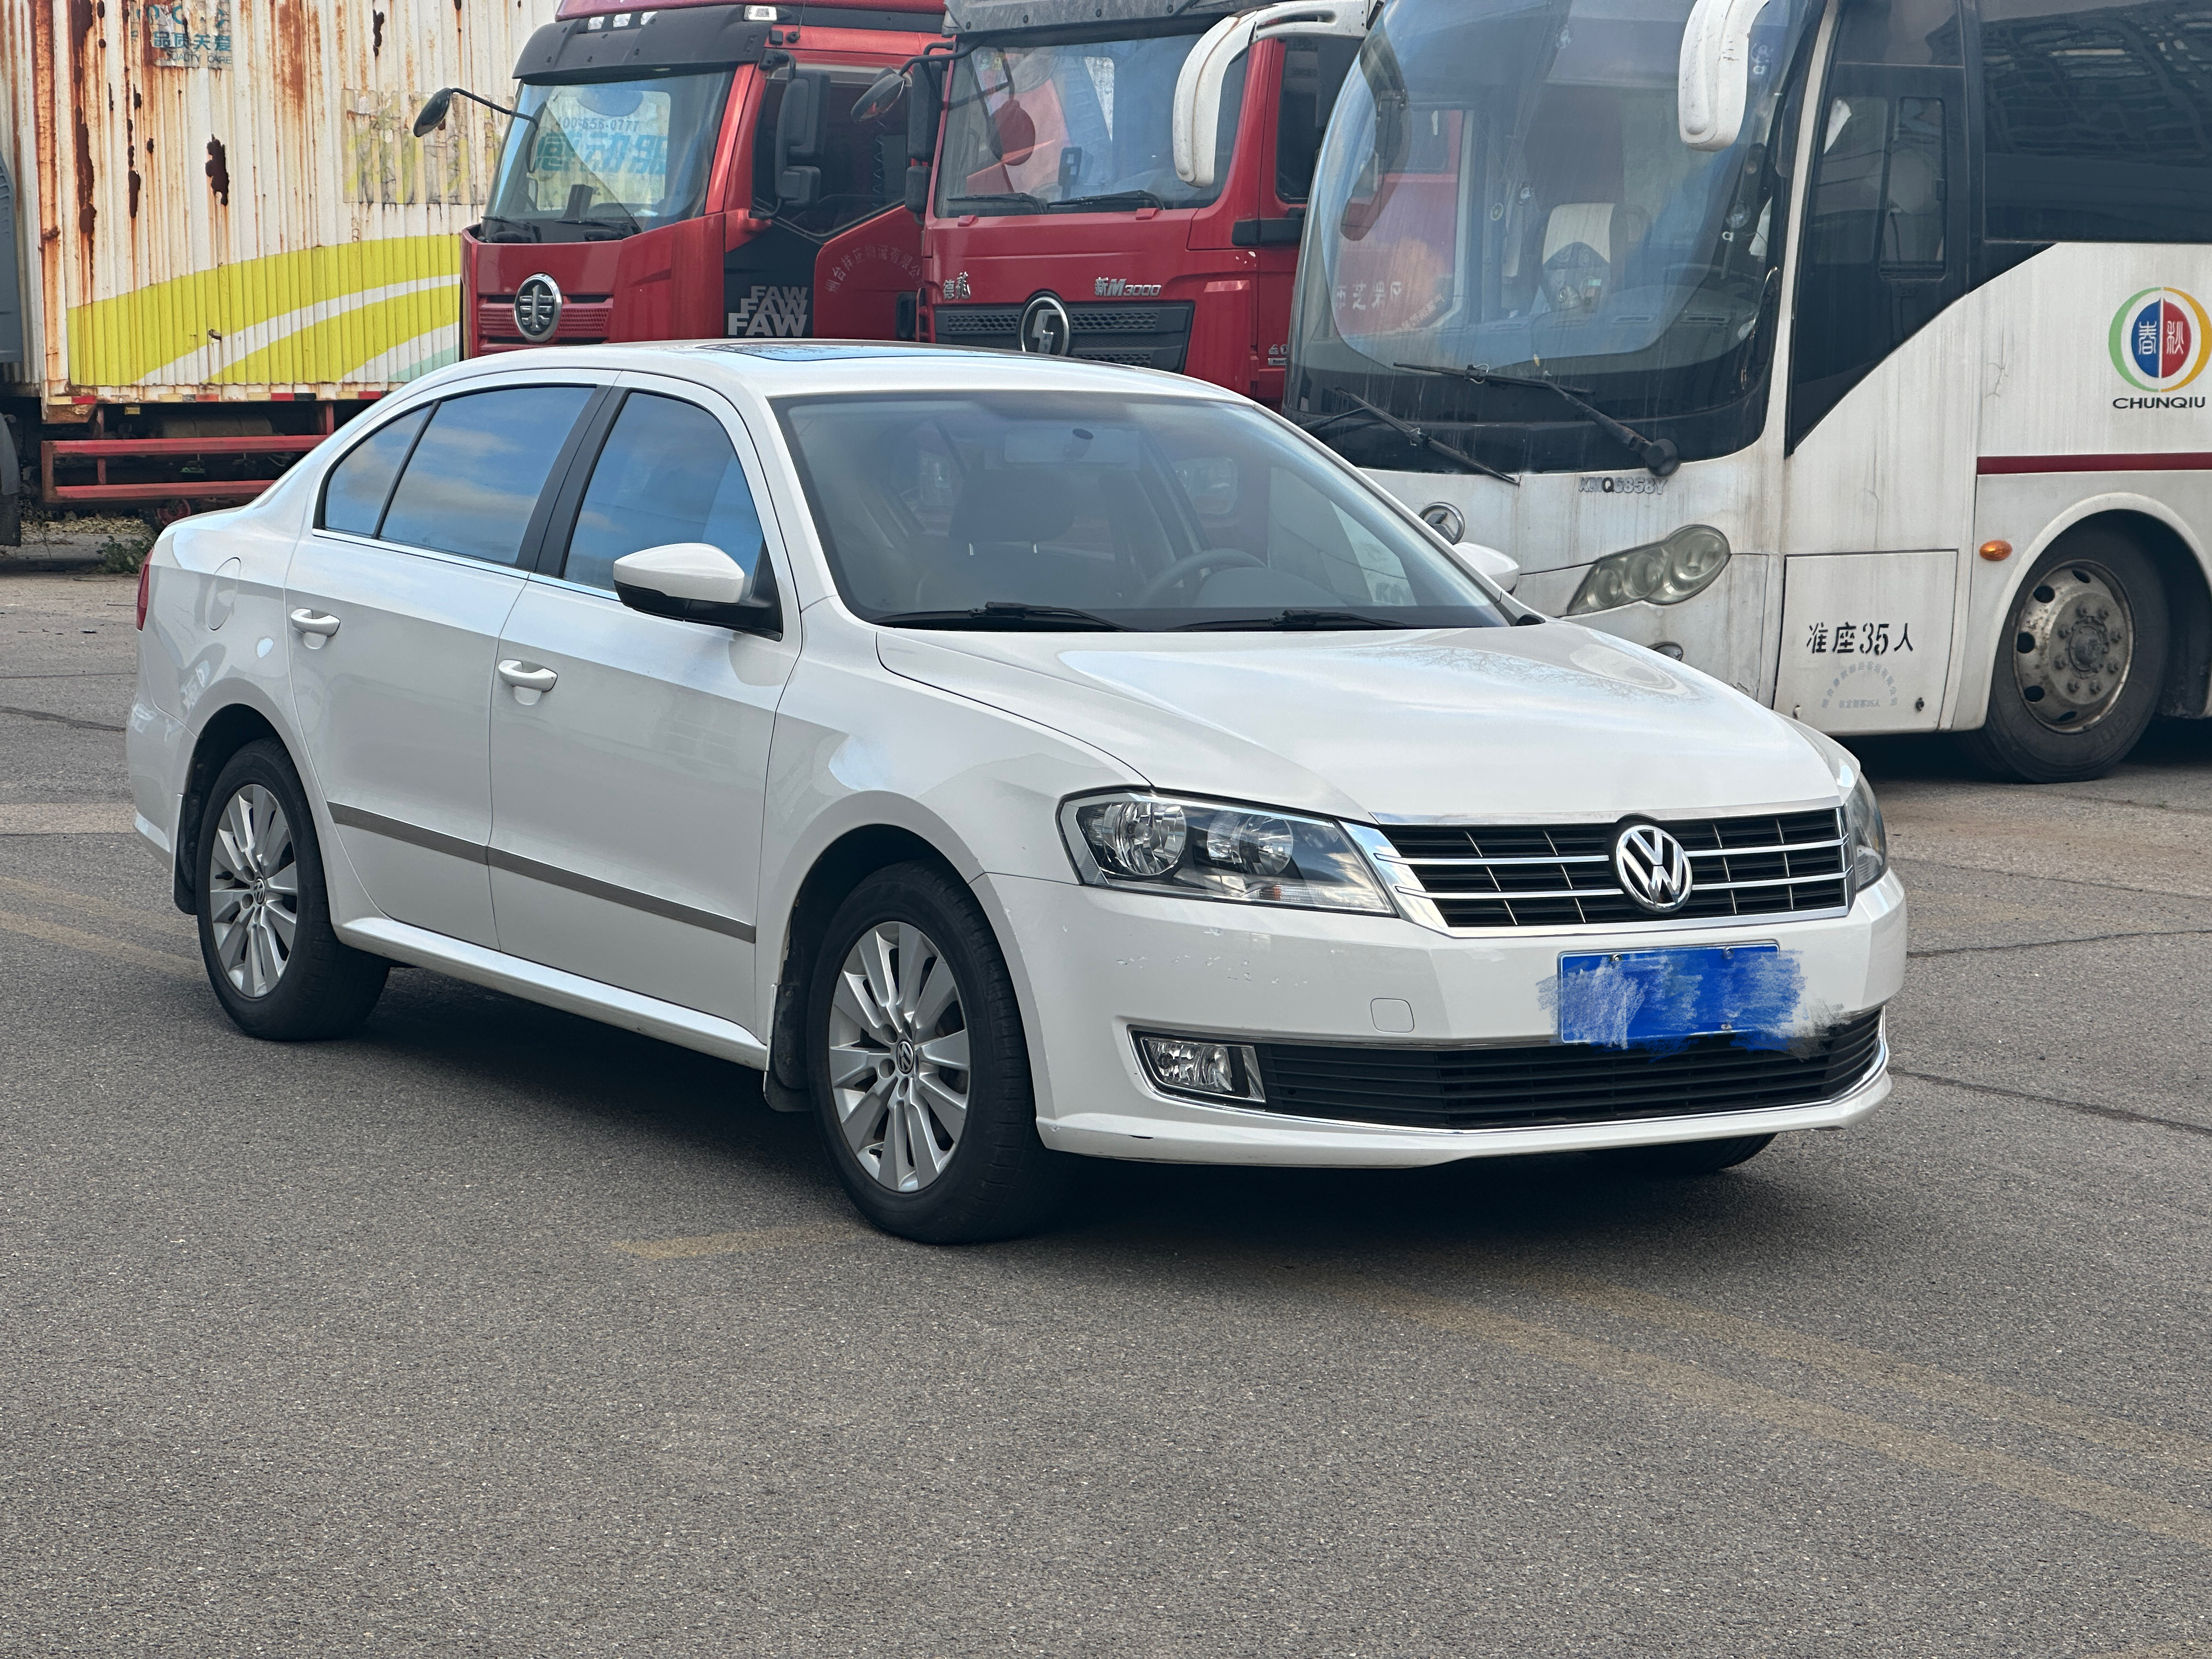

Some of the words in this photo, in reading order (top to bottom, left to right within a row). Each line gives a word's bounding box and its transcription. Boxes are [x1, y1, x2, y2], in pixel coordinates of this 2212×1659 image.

[154, 31, 231, 52] 品质关爱
[751, 285, 808, 301] FAW
[741, 298, 808, 318] FAW
[727, 312, 808, 337] FAW
[2137, 320, 2185, 355] 春秋
[2112, 396, 2206, 409] CHUNQIU
[1578, 476, 1668, 495] XMQ6858Y
[1806, 622, 1914, 656] 准座35人
